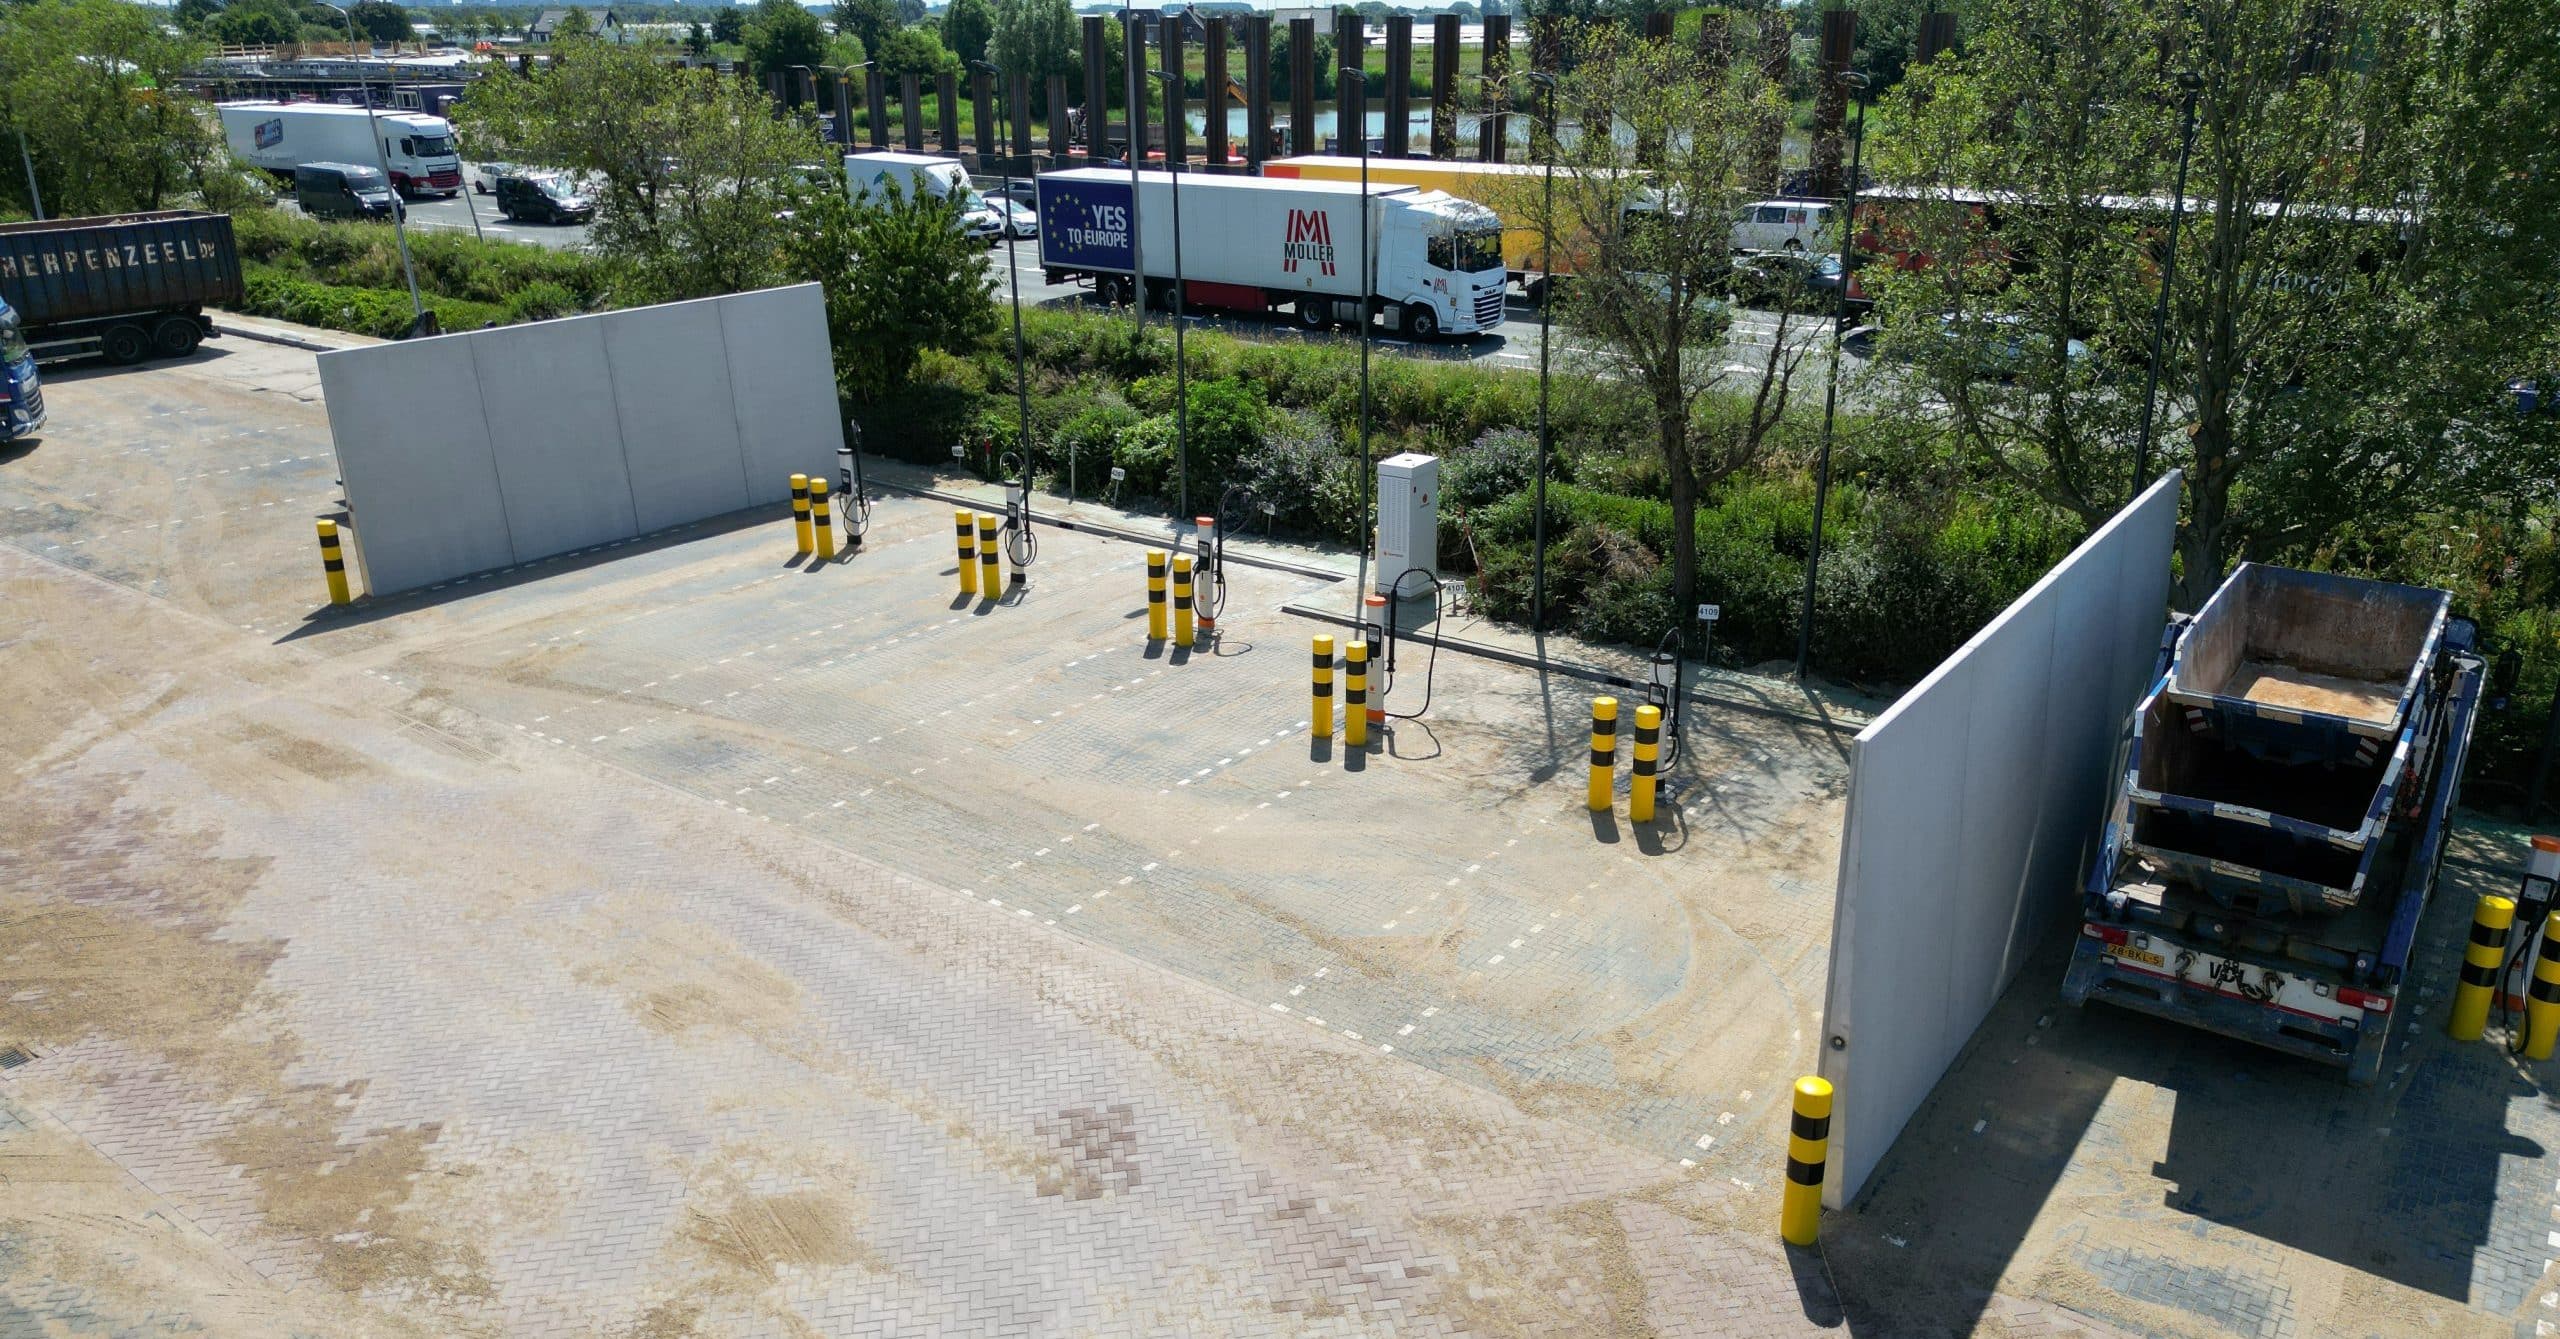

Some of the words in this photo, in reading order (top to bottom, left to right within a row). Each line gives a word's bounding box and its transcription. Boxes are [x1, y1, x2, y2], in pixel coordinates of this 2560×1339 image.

[1092, 204, 1127, 231] YES
[1067, 228, 1083, 244] TO
[1084, 230, 1129, 248] EUROPE
[1284, 243, 1334, 262] MOLLER
